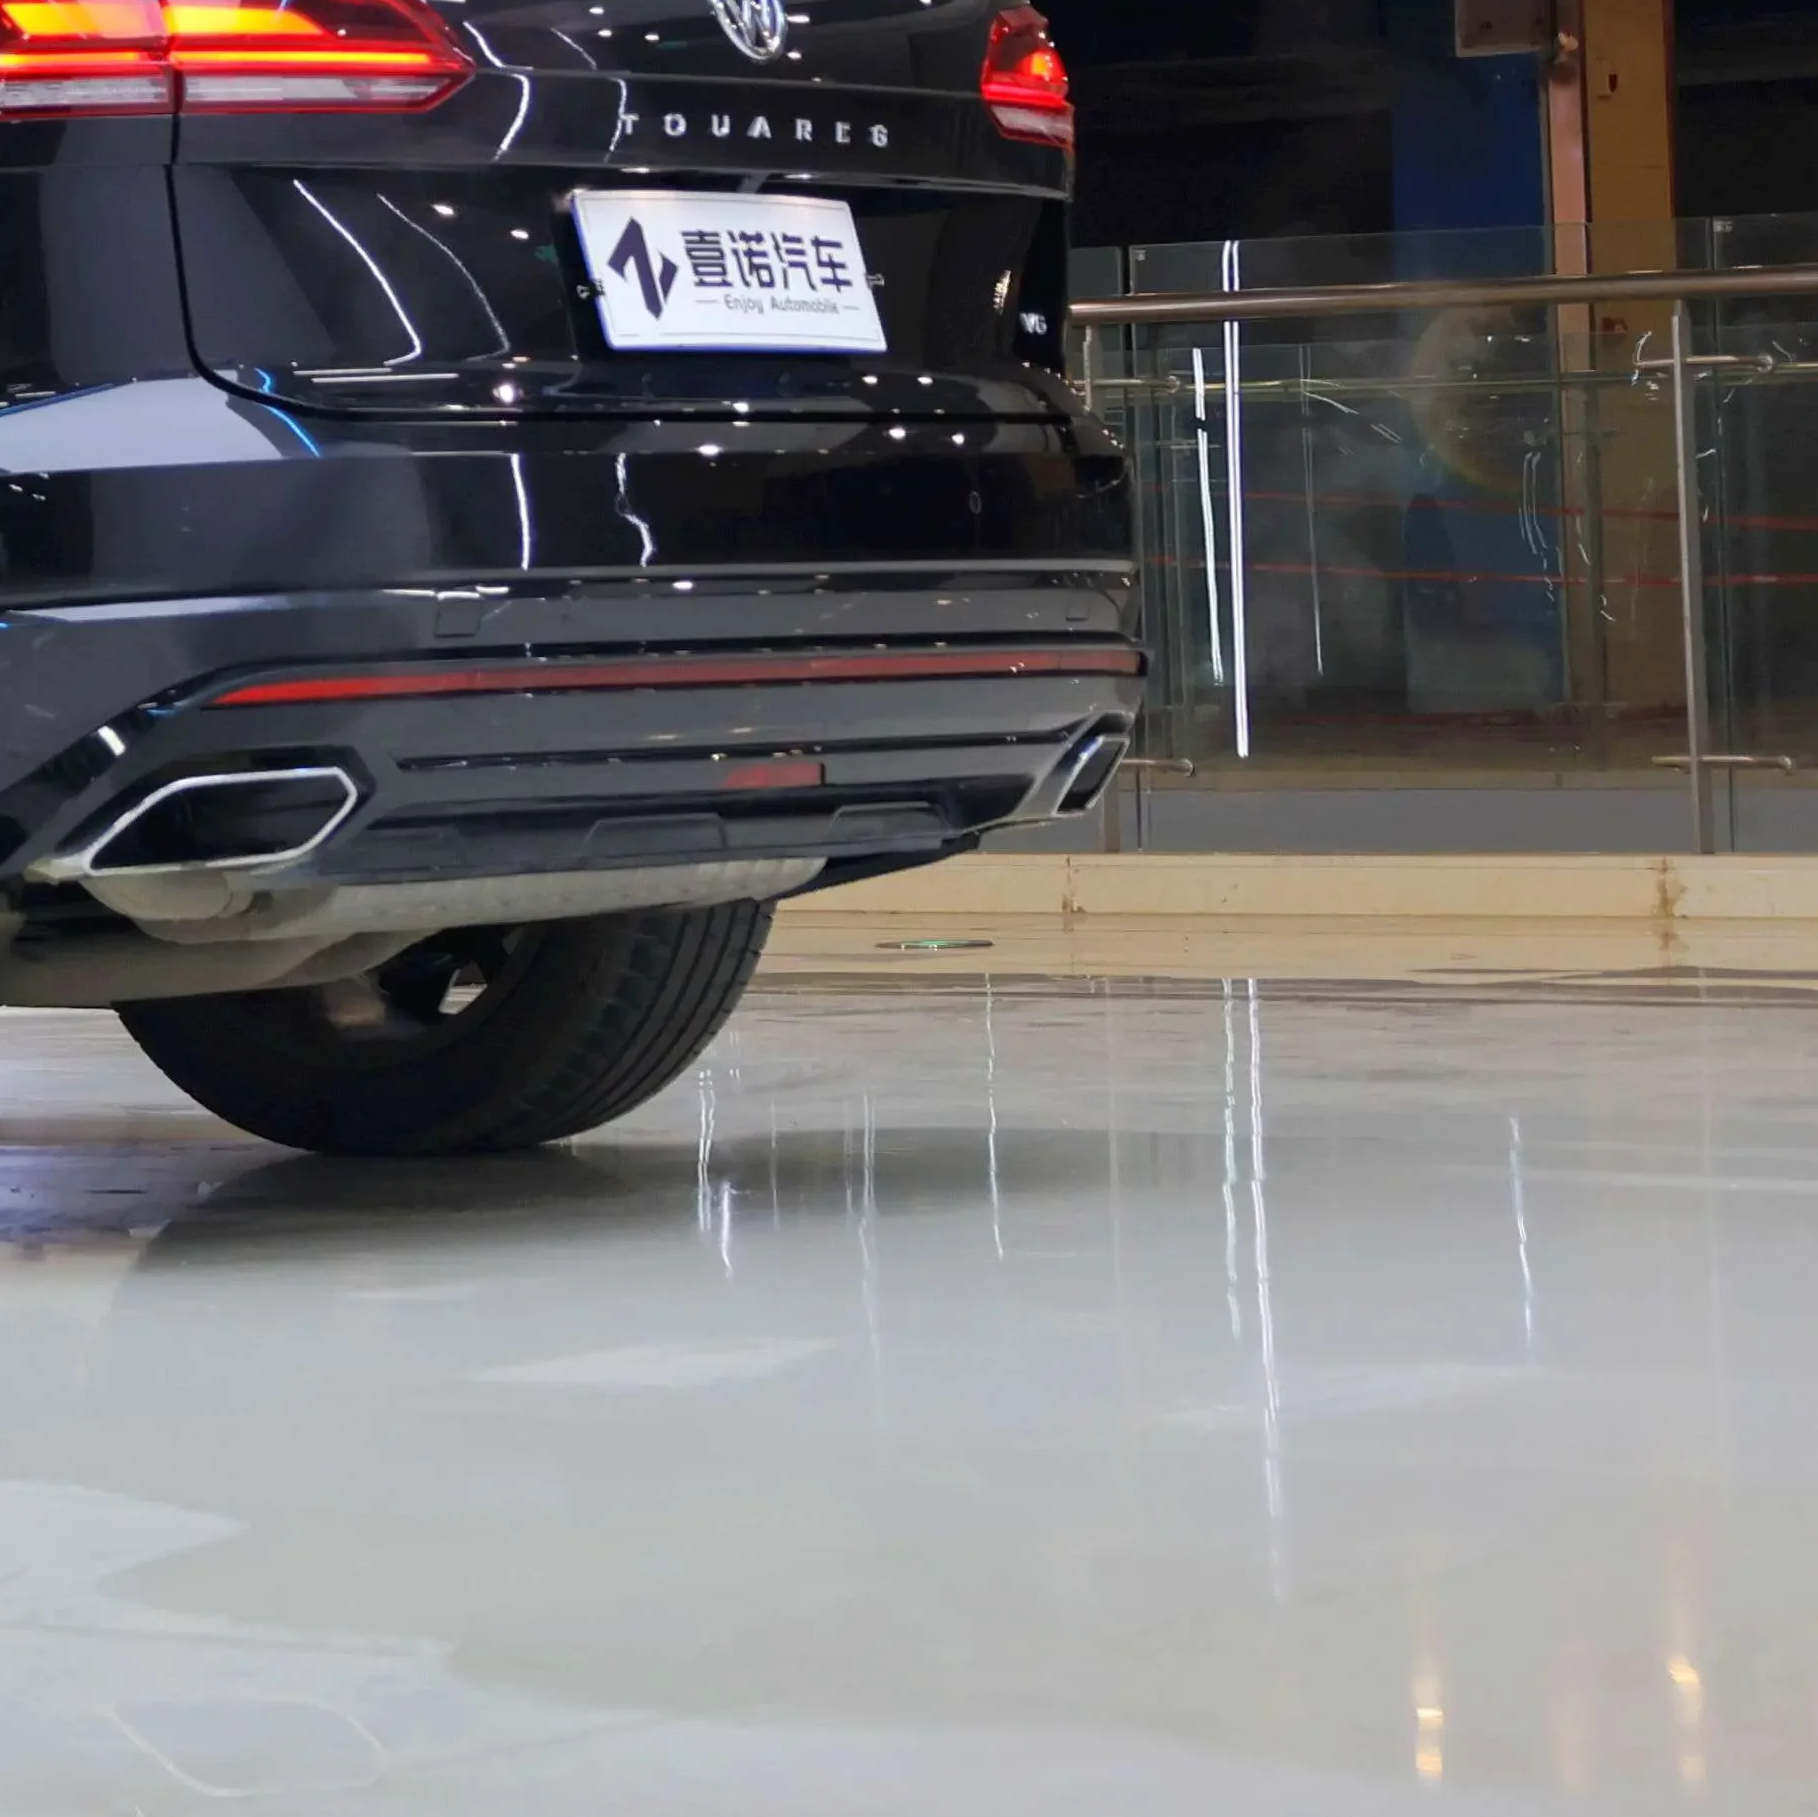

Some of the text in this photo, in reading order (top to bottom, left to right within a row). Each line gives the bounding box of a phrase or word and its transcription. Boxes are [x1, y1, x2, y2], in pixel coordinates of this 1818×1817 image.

[620, 113, 889, 147] TOUAREG
[680, 229, 853, 293] 壹诺汽车
[723, 293, 839, 314] Enjoy Automobile
